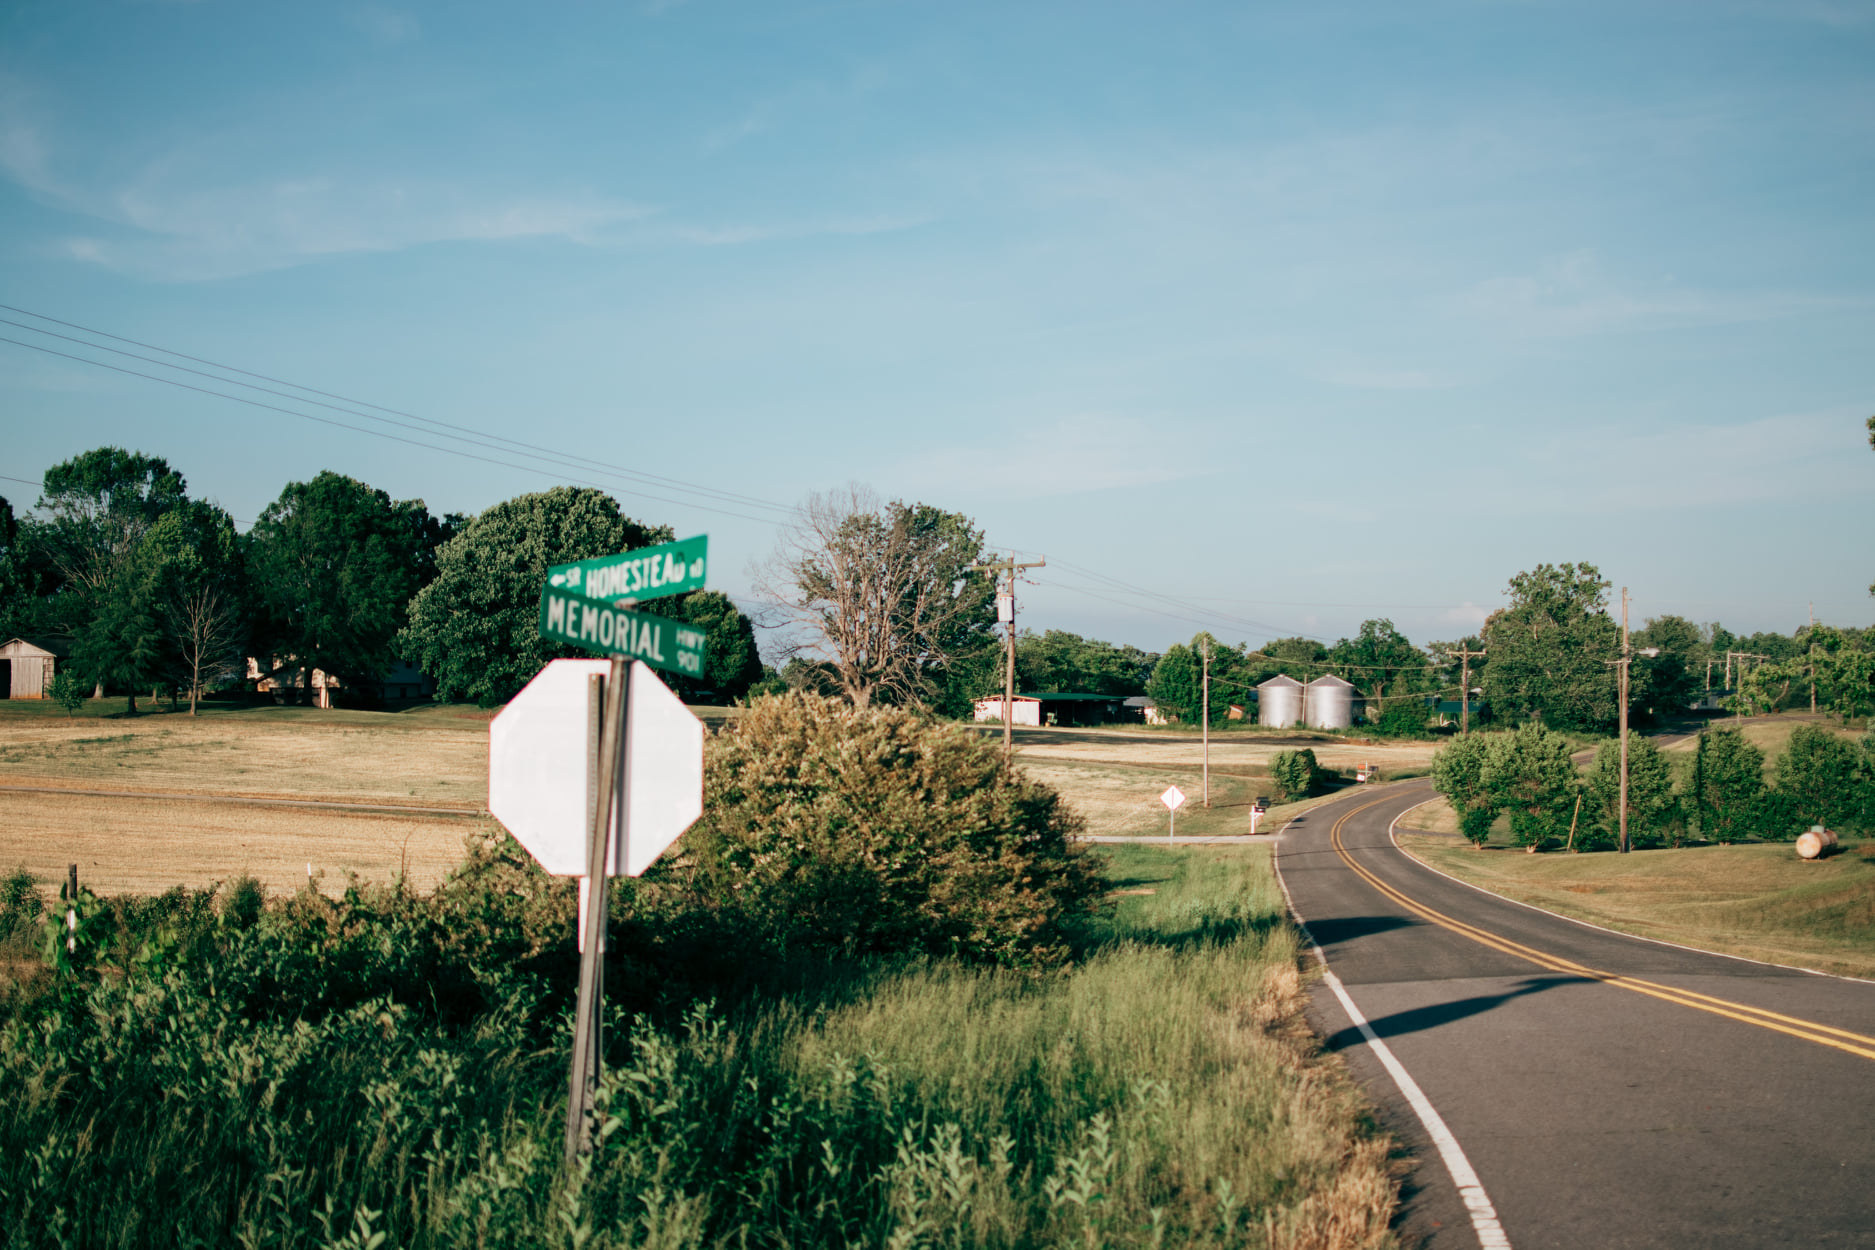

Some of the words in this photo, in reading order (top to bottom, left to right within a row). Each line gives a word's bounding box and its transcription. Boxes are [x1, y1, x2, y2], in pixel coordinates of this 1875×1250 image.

[547, 594, 665, 662] MEMORIAL
[676, 628, 705, 650] HWY
[676, 651, 700, 672] 901
